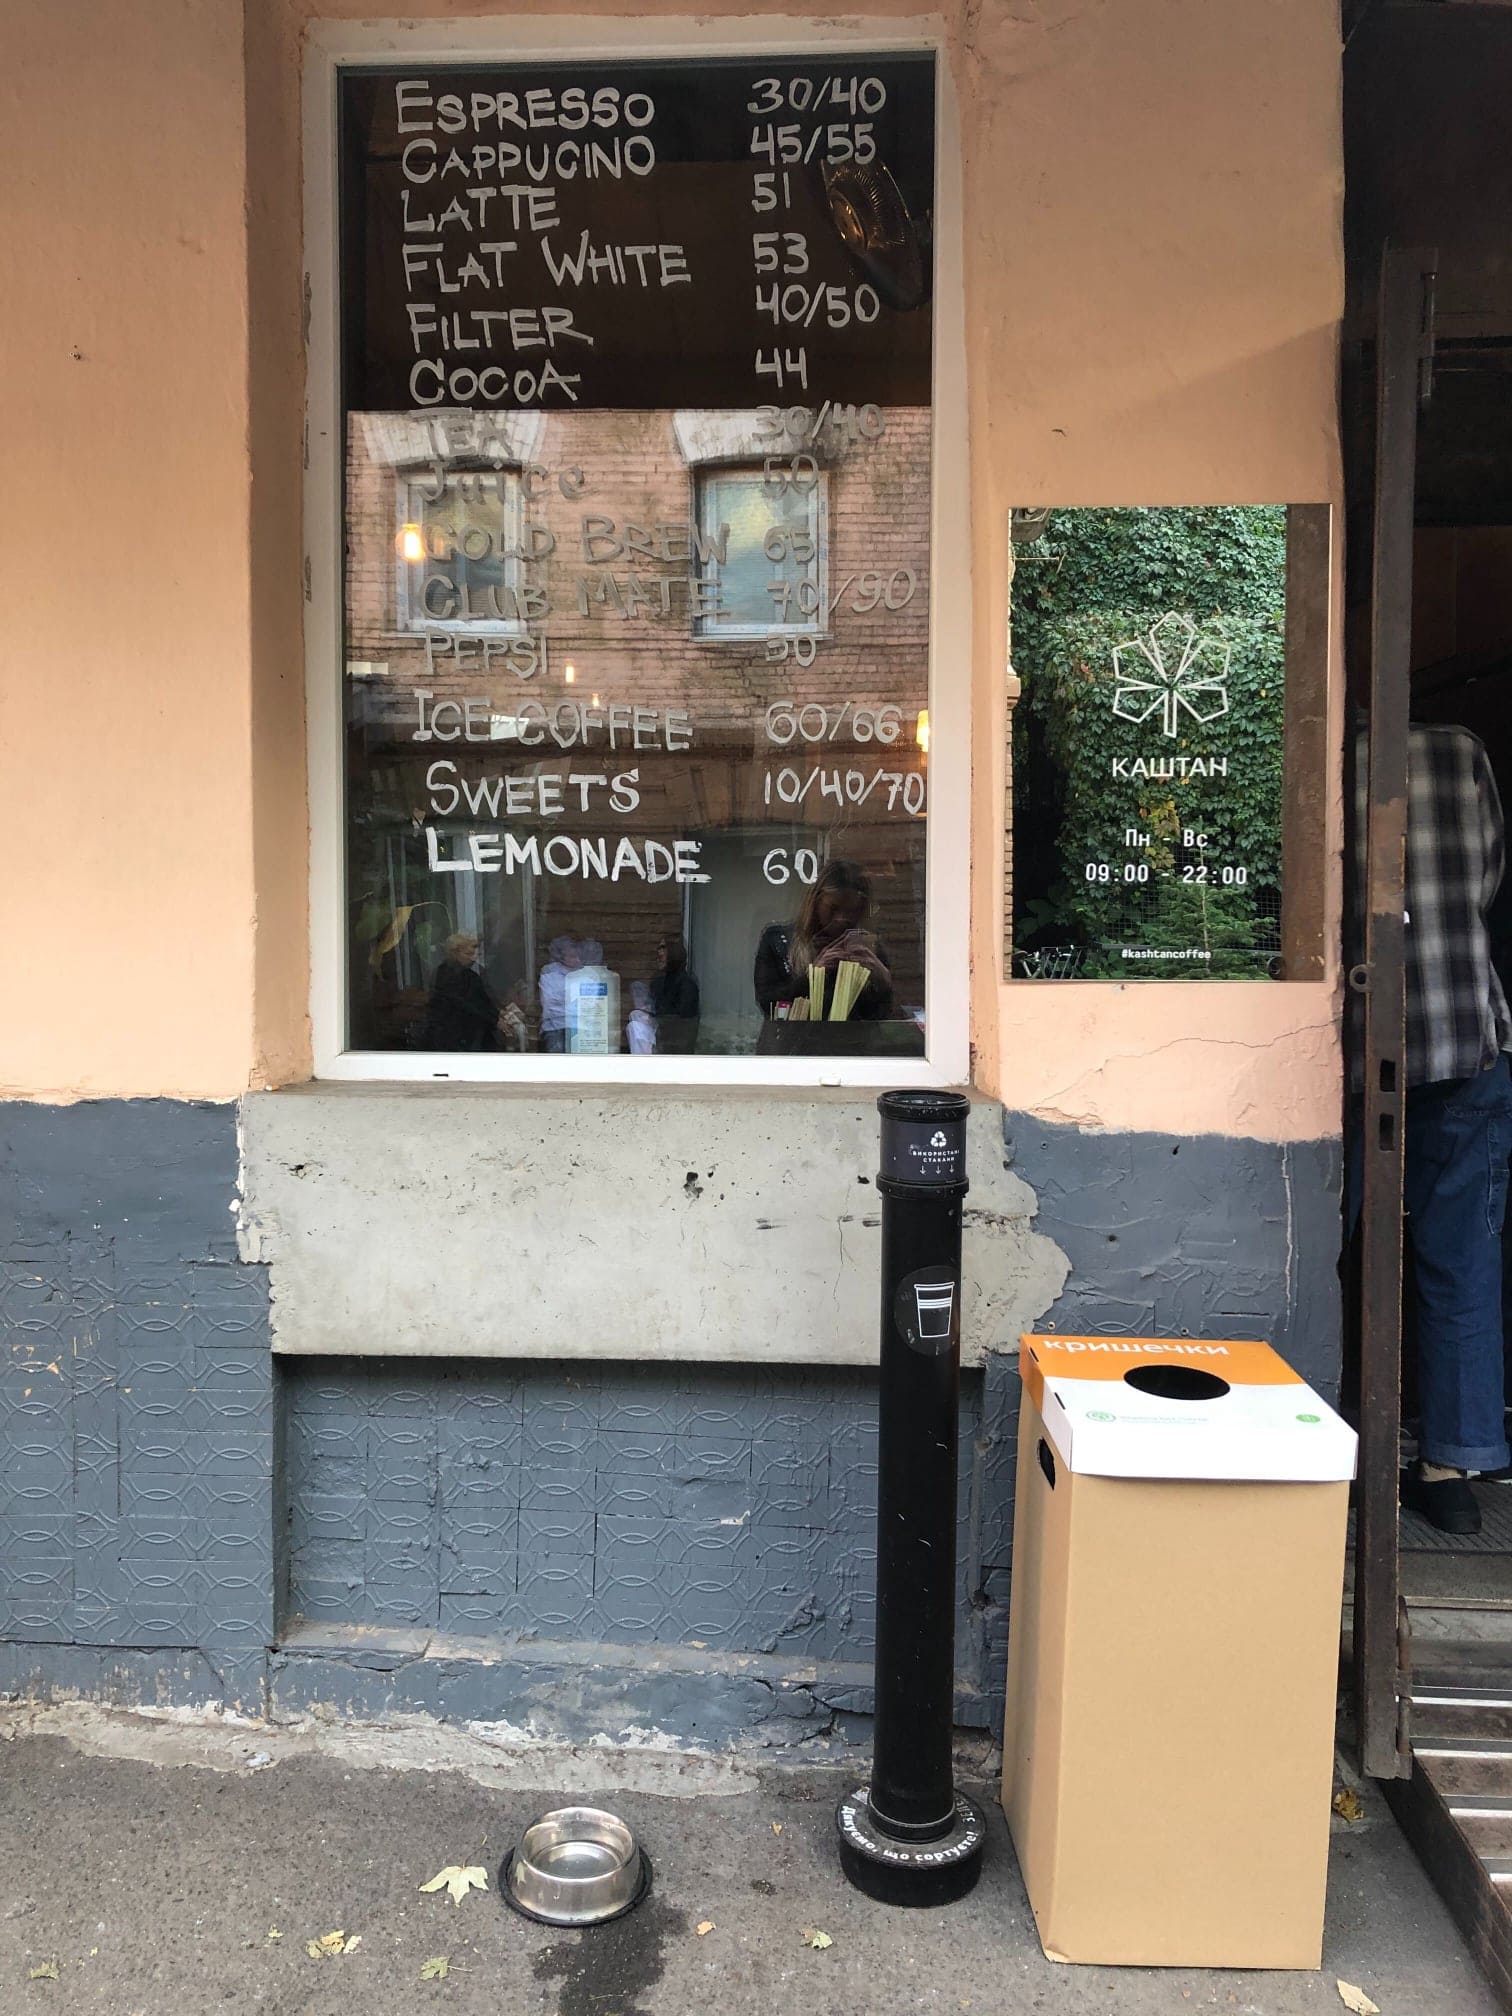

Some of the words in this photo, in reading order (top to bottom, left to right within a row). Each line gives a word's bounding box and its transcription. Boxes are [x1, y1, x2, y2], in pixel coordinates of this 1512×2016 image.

[395, 80, 655, 133] ESPRESSO
[747, 75, 887, 115] 30/40
[402, 134, 655, 184] CAPPUCINO
[750, 122, 876, 166] 45/55
[401, 184, 561, 232] LATTE
[752, 171, 791, 212] 51
[402, 241, 518, 293] FLAT
[541, 229, 692, 287] WHITE
[753, 231, 809, 274] 53
[405, 303, 594, 353] FILTER
[756, 281, 881, 328] 40/50
[409, 357, 582, 405] COCOA
[754, 347, 808, 390] 44
[409, 407, 514, 458] TEA
[751, 400, 886, 443] 30/40
[424, 521, 556, 562] COLD
[582, 514, 731, 566] BREW
[763, 525, 815, 563] 65
[419, 574, 553, 621] CLUB
[575, 573, 731, 619] MATE
[766, 567, 917, 622] 70/90
[423, 625, 549, 680] PEPSI
[412, 688, 491, 742] ICE
[516, 702, 694, 751] COFFEE
[765, 700, 903, 745] 60/66
[425, 760, 641, 818] SWEETS
[765, 766, 925, 815] 10/40/70
[1111, 757, 1228, 778] КАШТАН
[424, 826, 713, 885] LEMONADE
[762, 848, 818, 885] 60
[1125, 829, 1151, 847] Пн
[1183, 829, 1209, 848] Вс
[1085, 863, 1149, 883] 09:00
[1182, 865, 1248, 885] 22:00
[1121, 948, 1212, 959] #kashtancoffee
[1042, 1340, 1231, 1356] кришечки
[882, 1849, 910, 1861] що
